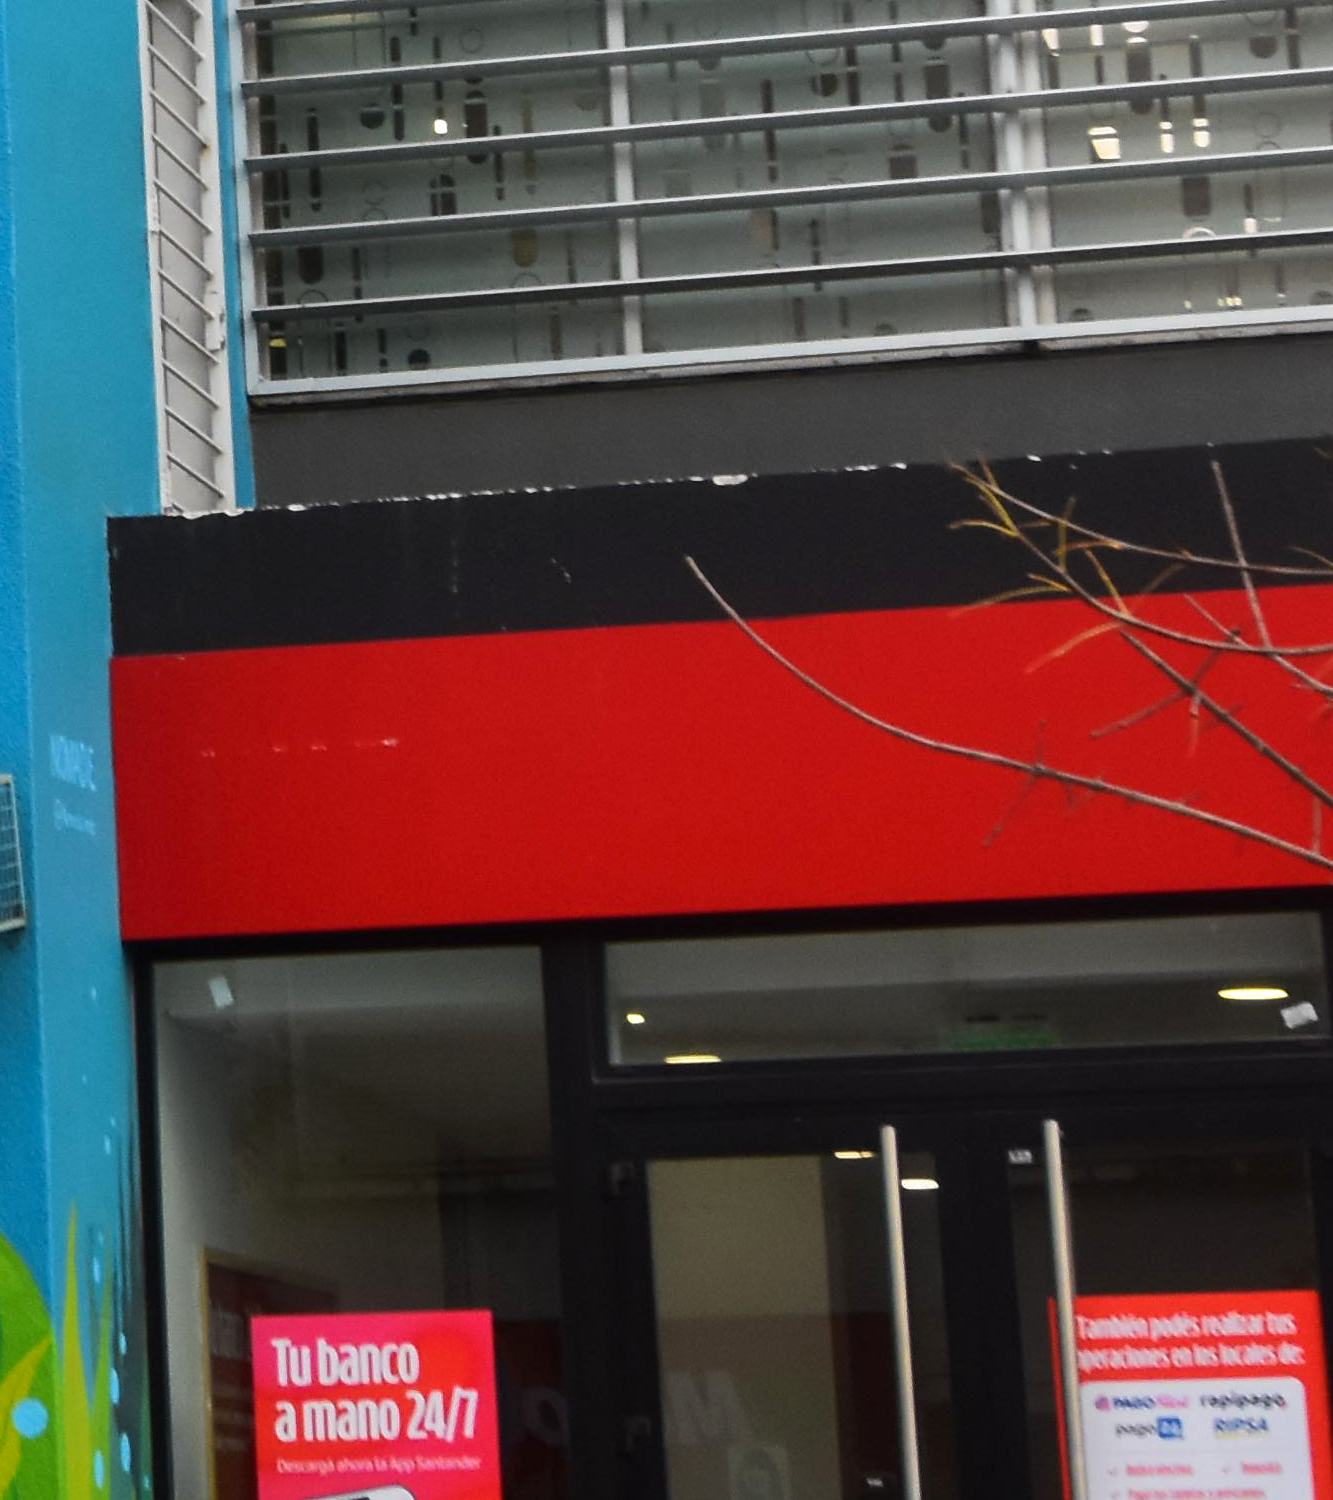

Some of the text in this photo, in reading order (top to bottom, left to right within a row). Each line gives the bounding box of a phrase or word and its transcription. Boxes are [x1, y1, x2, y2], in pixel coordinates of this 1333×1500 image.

[271, 1336, 420, 1387] Tu banco
[275, 1385, 479, 1443] a mano 24/7
